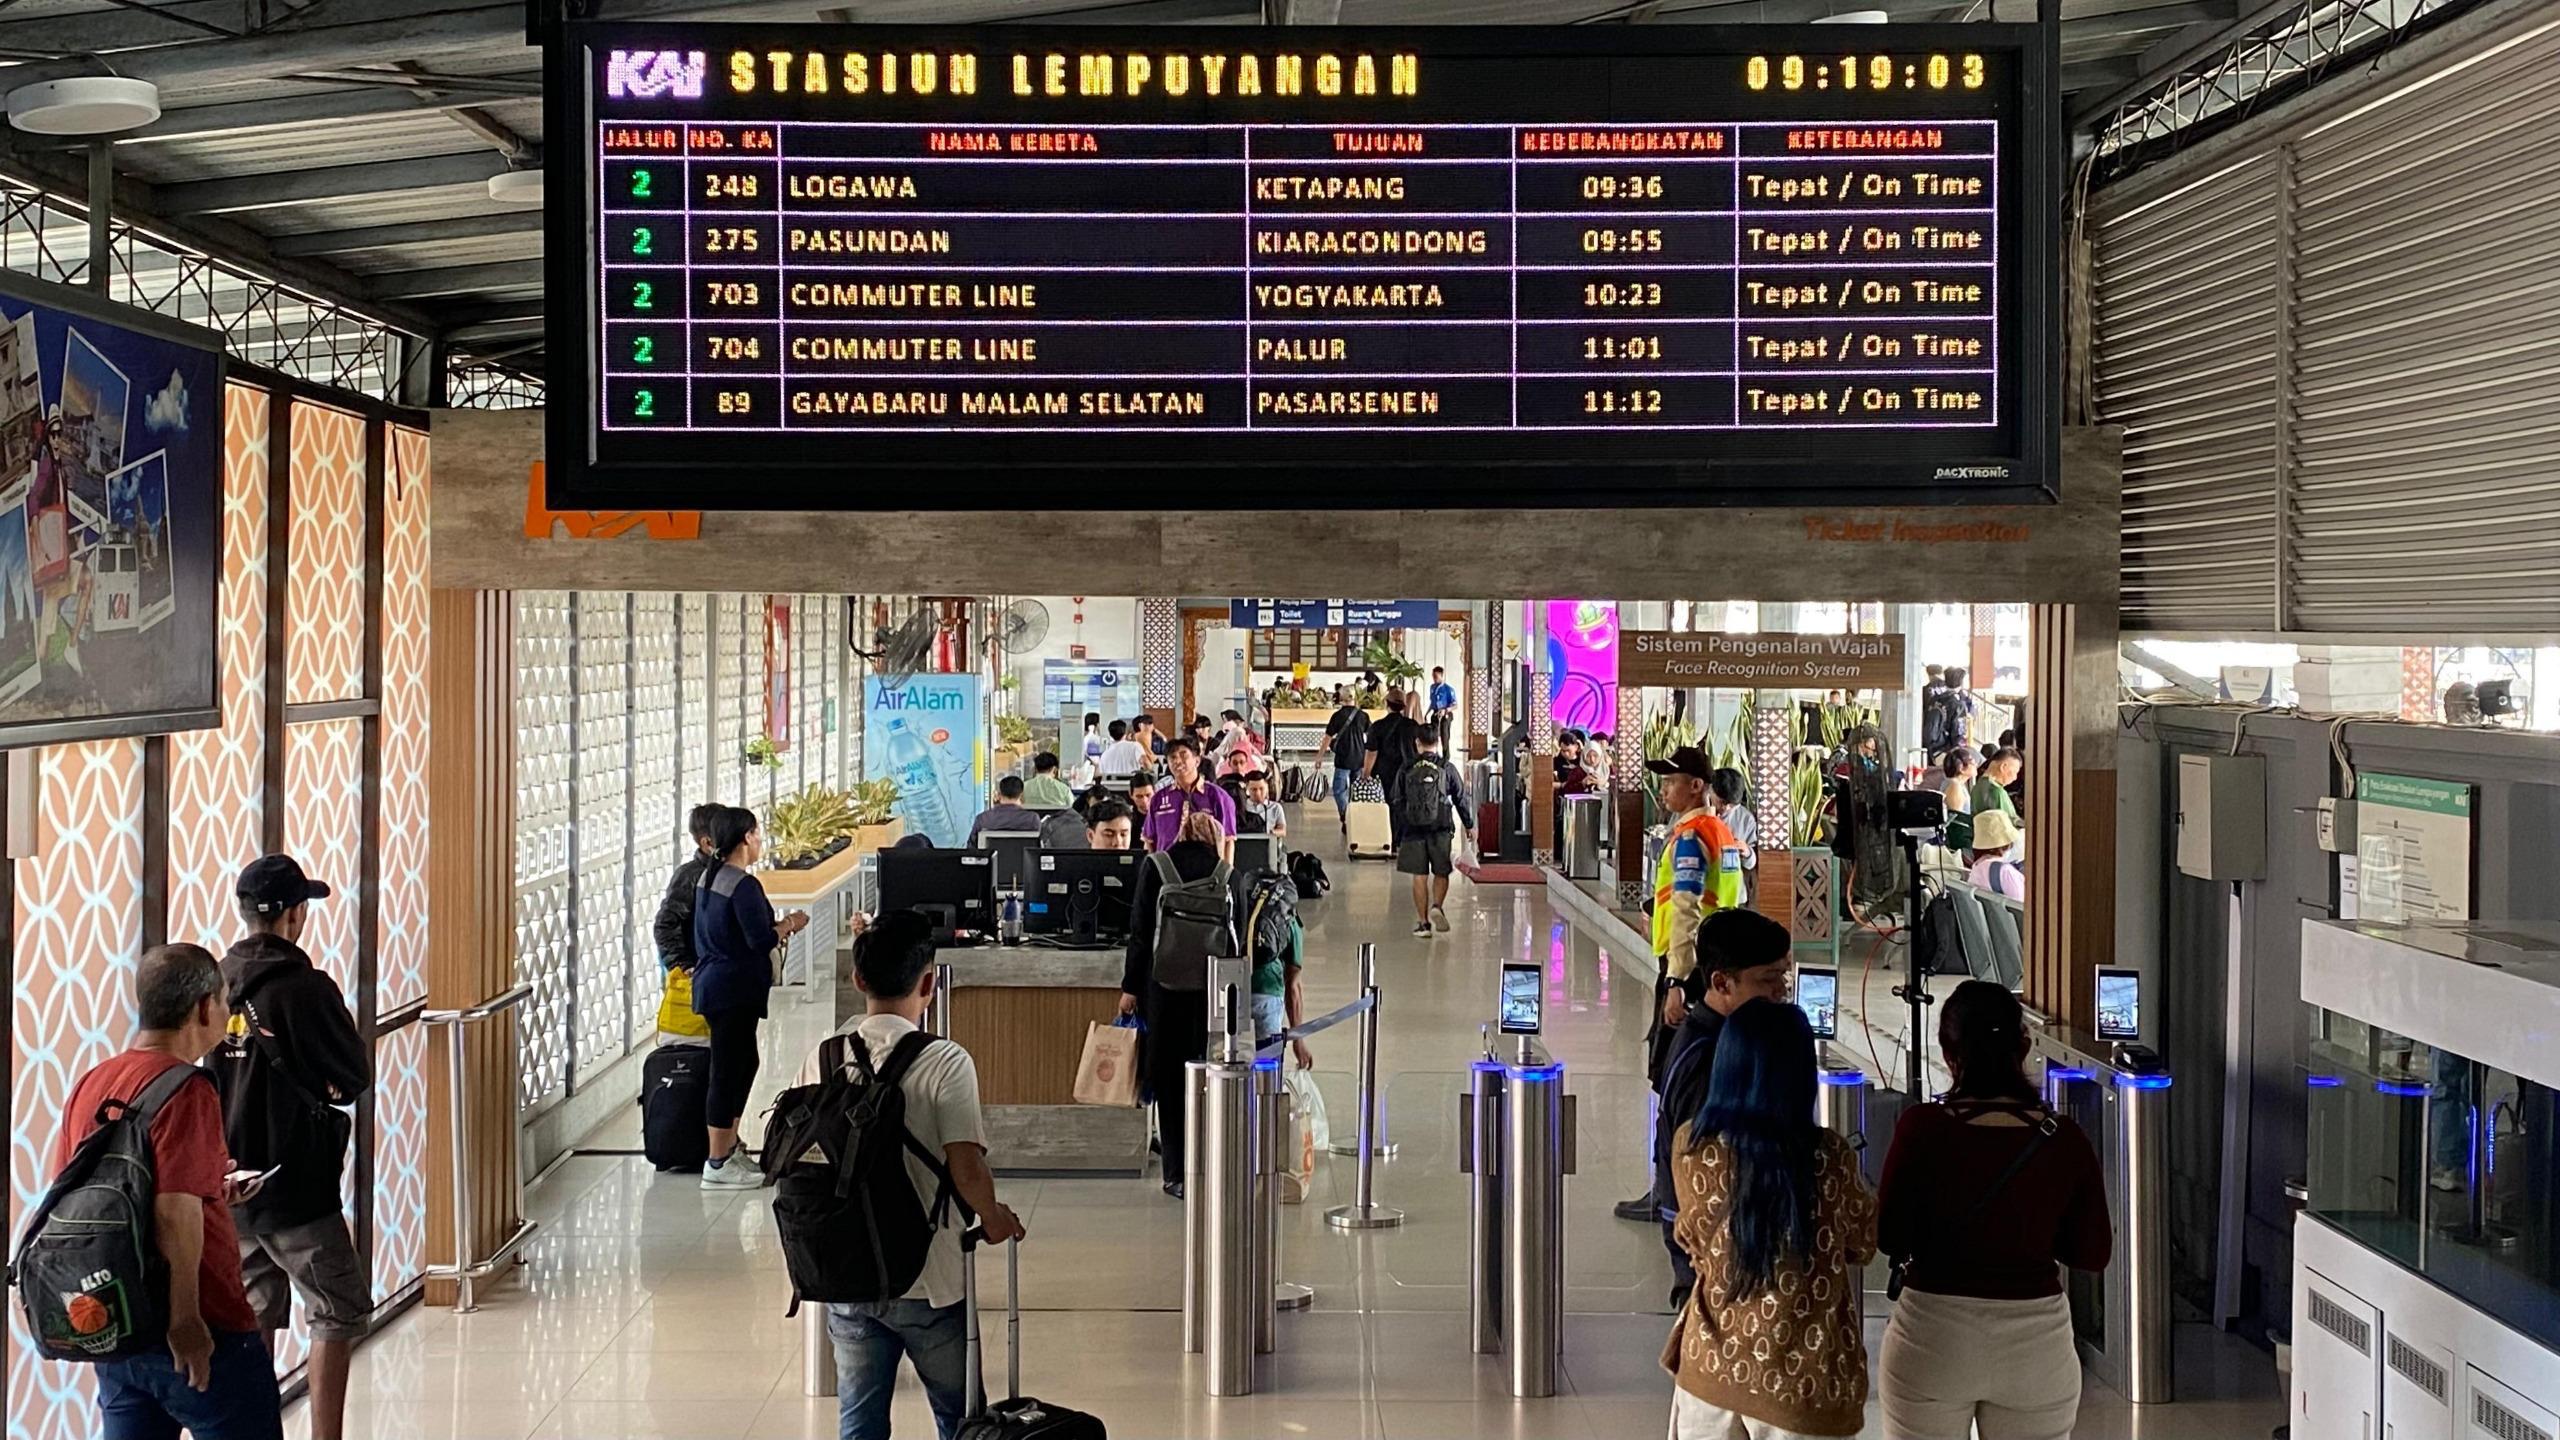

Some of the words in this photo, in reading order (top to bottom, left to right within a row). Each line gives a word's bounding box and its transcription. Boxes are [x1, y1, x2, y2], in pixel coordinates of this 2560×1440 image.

[730, 51, 977, 95] STASIUN
[1013, 53, 1418, 97] LEMPUYANGAN
[1747, 54, 1985, 91] 09:19:03
[605, 130, 677, 149] JALUR
[689, 130, 734, 149] NO.
[742, 131, 773, 149] KA
[931, 132, 1002, 151] NAMA
[1010, 133, 1098, 152] KERETA
[1332, 132, 1423, 152] TUJUAN
[1522, 131, 1724, 152] KEBERANGKATAN
[1788, 130, 1943, 150] KETERANGAN
[632, 170, 651, 197] 2
[706, 175, 757, 197] 248
[790, 176, 917, 198] LOGAWA
[1256, 177, 1405, 200] KETAPANG
[1583, 176, 1664, 199] 09:36
[1746, 174, 1829, 201] Tepat
[1838, 173, 1854, 201] /
[1863, 174, 1901, 196] On
[1911, 174, 1982, 195] Time
[632, 227, 652, 254] 2
[706, 228, 758, 252] 275
[790, 230, 950, 253] PASUNDAN
[1256, 230, 1488, 254] KIARACONDONG
[1583, 229, 1663, 252] 09:55
[1746, 227, 1829, 254] Tepat
[1838, 226, 1854, 254] /
[1863, 227, 1901, 249] On
[1911, 227, 1982, 248] Time
[633, 282, 652, 308] 2
[707, 282, 759, 305] 703
[791, 284, 963, 307] COMMUTER
[973, 285, 1036, 308] LINE
[1254, 284, 1444, 307] YOGYAKARTA
[1583, 283, 1662, 306] 10:23
[1746, 281, 1829, 308] Tepat
[1838, 280, 1854, 308] /
[1863, 281, 1901, 303] On
[1911, 281, 1982, 302] Time
[633, 336, 653, 362] 2
[708, 336, 760, 359] 704
[791, 338, 963, 361] COMMUTER
[973, 338, 1037, 361] LINE
[1256, 338, 1348, 361] PALUR
[1584, 337, 1662, 360] 11:01
[1746, 334, 1829, 361] Tepat
[1838, 333, 1854, 361] /
[1863, 334, 1901, 356] On
[1911, 334, 1982, 355] Time
[634, 390, 654, 416] 2
[718, 391, 751, 414] 89
[792, 391, 948, 415] GAYABARU
[962, 392, 1069, 415] MALAM
[1080, 391, 1204, 415] SELATAN
[1256, 391, 1440, 414] PASARSENEN
[1584, 390, 1662, 413] 11:12
[1746, 388, 1829, 415] Tepat
[1838, 387, 1854, 415] /
[1863, 388, 1901, 410] On
[1911, 388, 1982, 409] Time
[1934, 466, 2009, 479] DACXTRONIC
[1279, 609, 1302, 619] Toilet
[1347, 610, 1372, 619] Ruang
[1373, 610, 1402, 619] Tunggu
[1636, 635, 1703, 653] Sistem
[1708, 638, 1822, 656] Pengenalan
[1829, 639, 1891, 659] Wajah
[1664, 660, 1703, 675] Face
[1707, 661, 1800, 678] Recognition
[1804, 662, 1861, 678] System
[874, 685, 964, 710] AirAlam
[80, 1269, 112, 1292] ALTO
